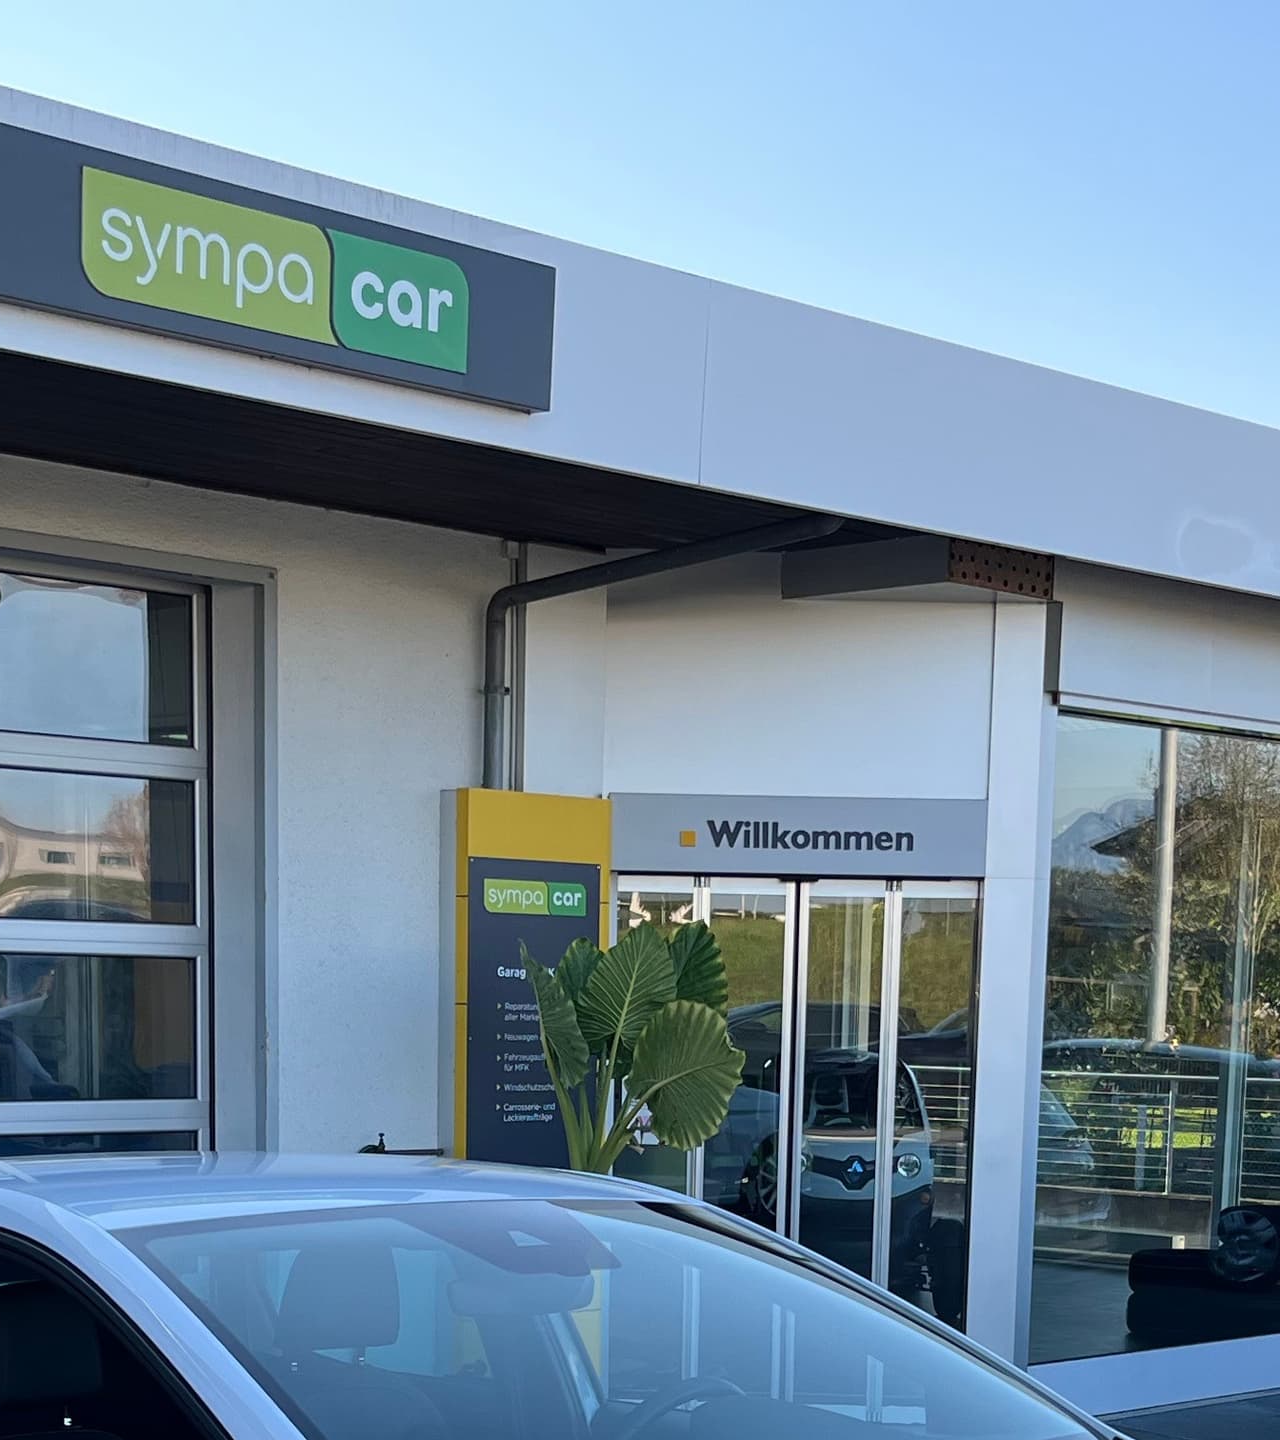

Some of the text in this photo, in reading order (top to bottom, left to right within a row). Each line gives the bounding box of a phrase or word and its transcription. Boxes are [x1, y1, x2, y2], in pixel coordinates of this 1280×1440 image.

[100, 207, 454, 332] sympa car
[706, 820, 914, 852] Willkommen
[488, 888, 582, 909] sympa car
[497, 966, 527, 980] Garag
[520, 1013, 540, 1021] Marke
[503, 1083, 555, 1092] Windschutzsche
[543, 1102, 556, 1111] und
